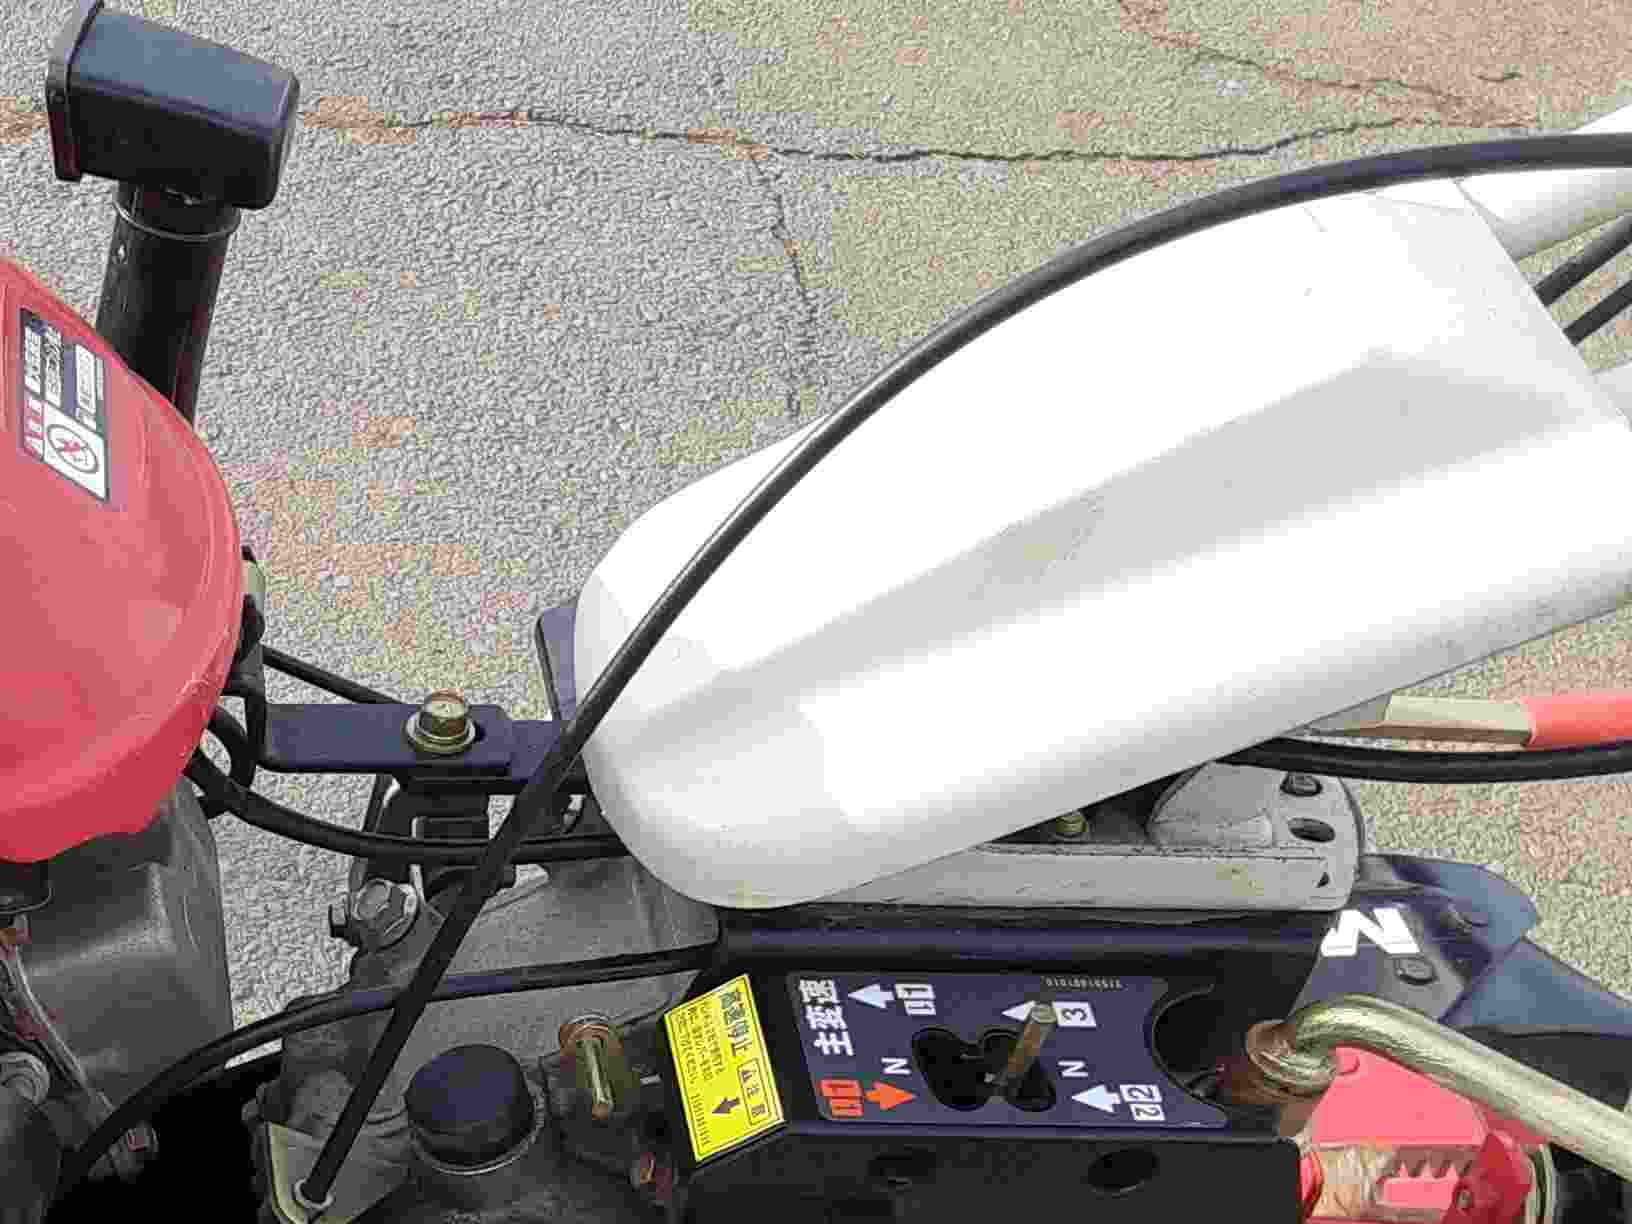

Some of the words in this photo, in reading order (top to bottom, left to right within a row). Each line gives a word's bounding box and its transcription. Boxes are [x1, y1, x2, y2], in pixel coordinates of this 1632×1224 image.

[799, 979, 854, 1056] 主変速
[881, 1057, 912, 1074] N
[1057, 1060, 1089, 1078] N
